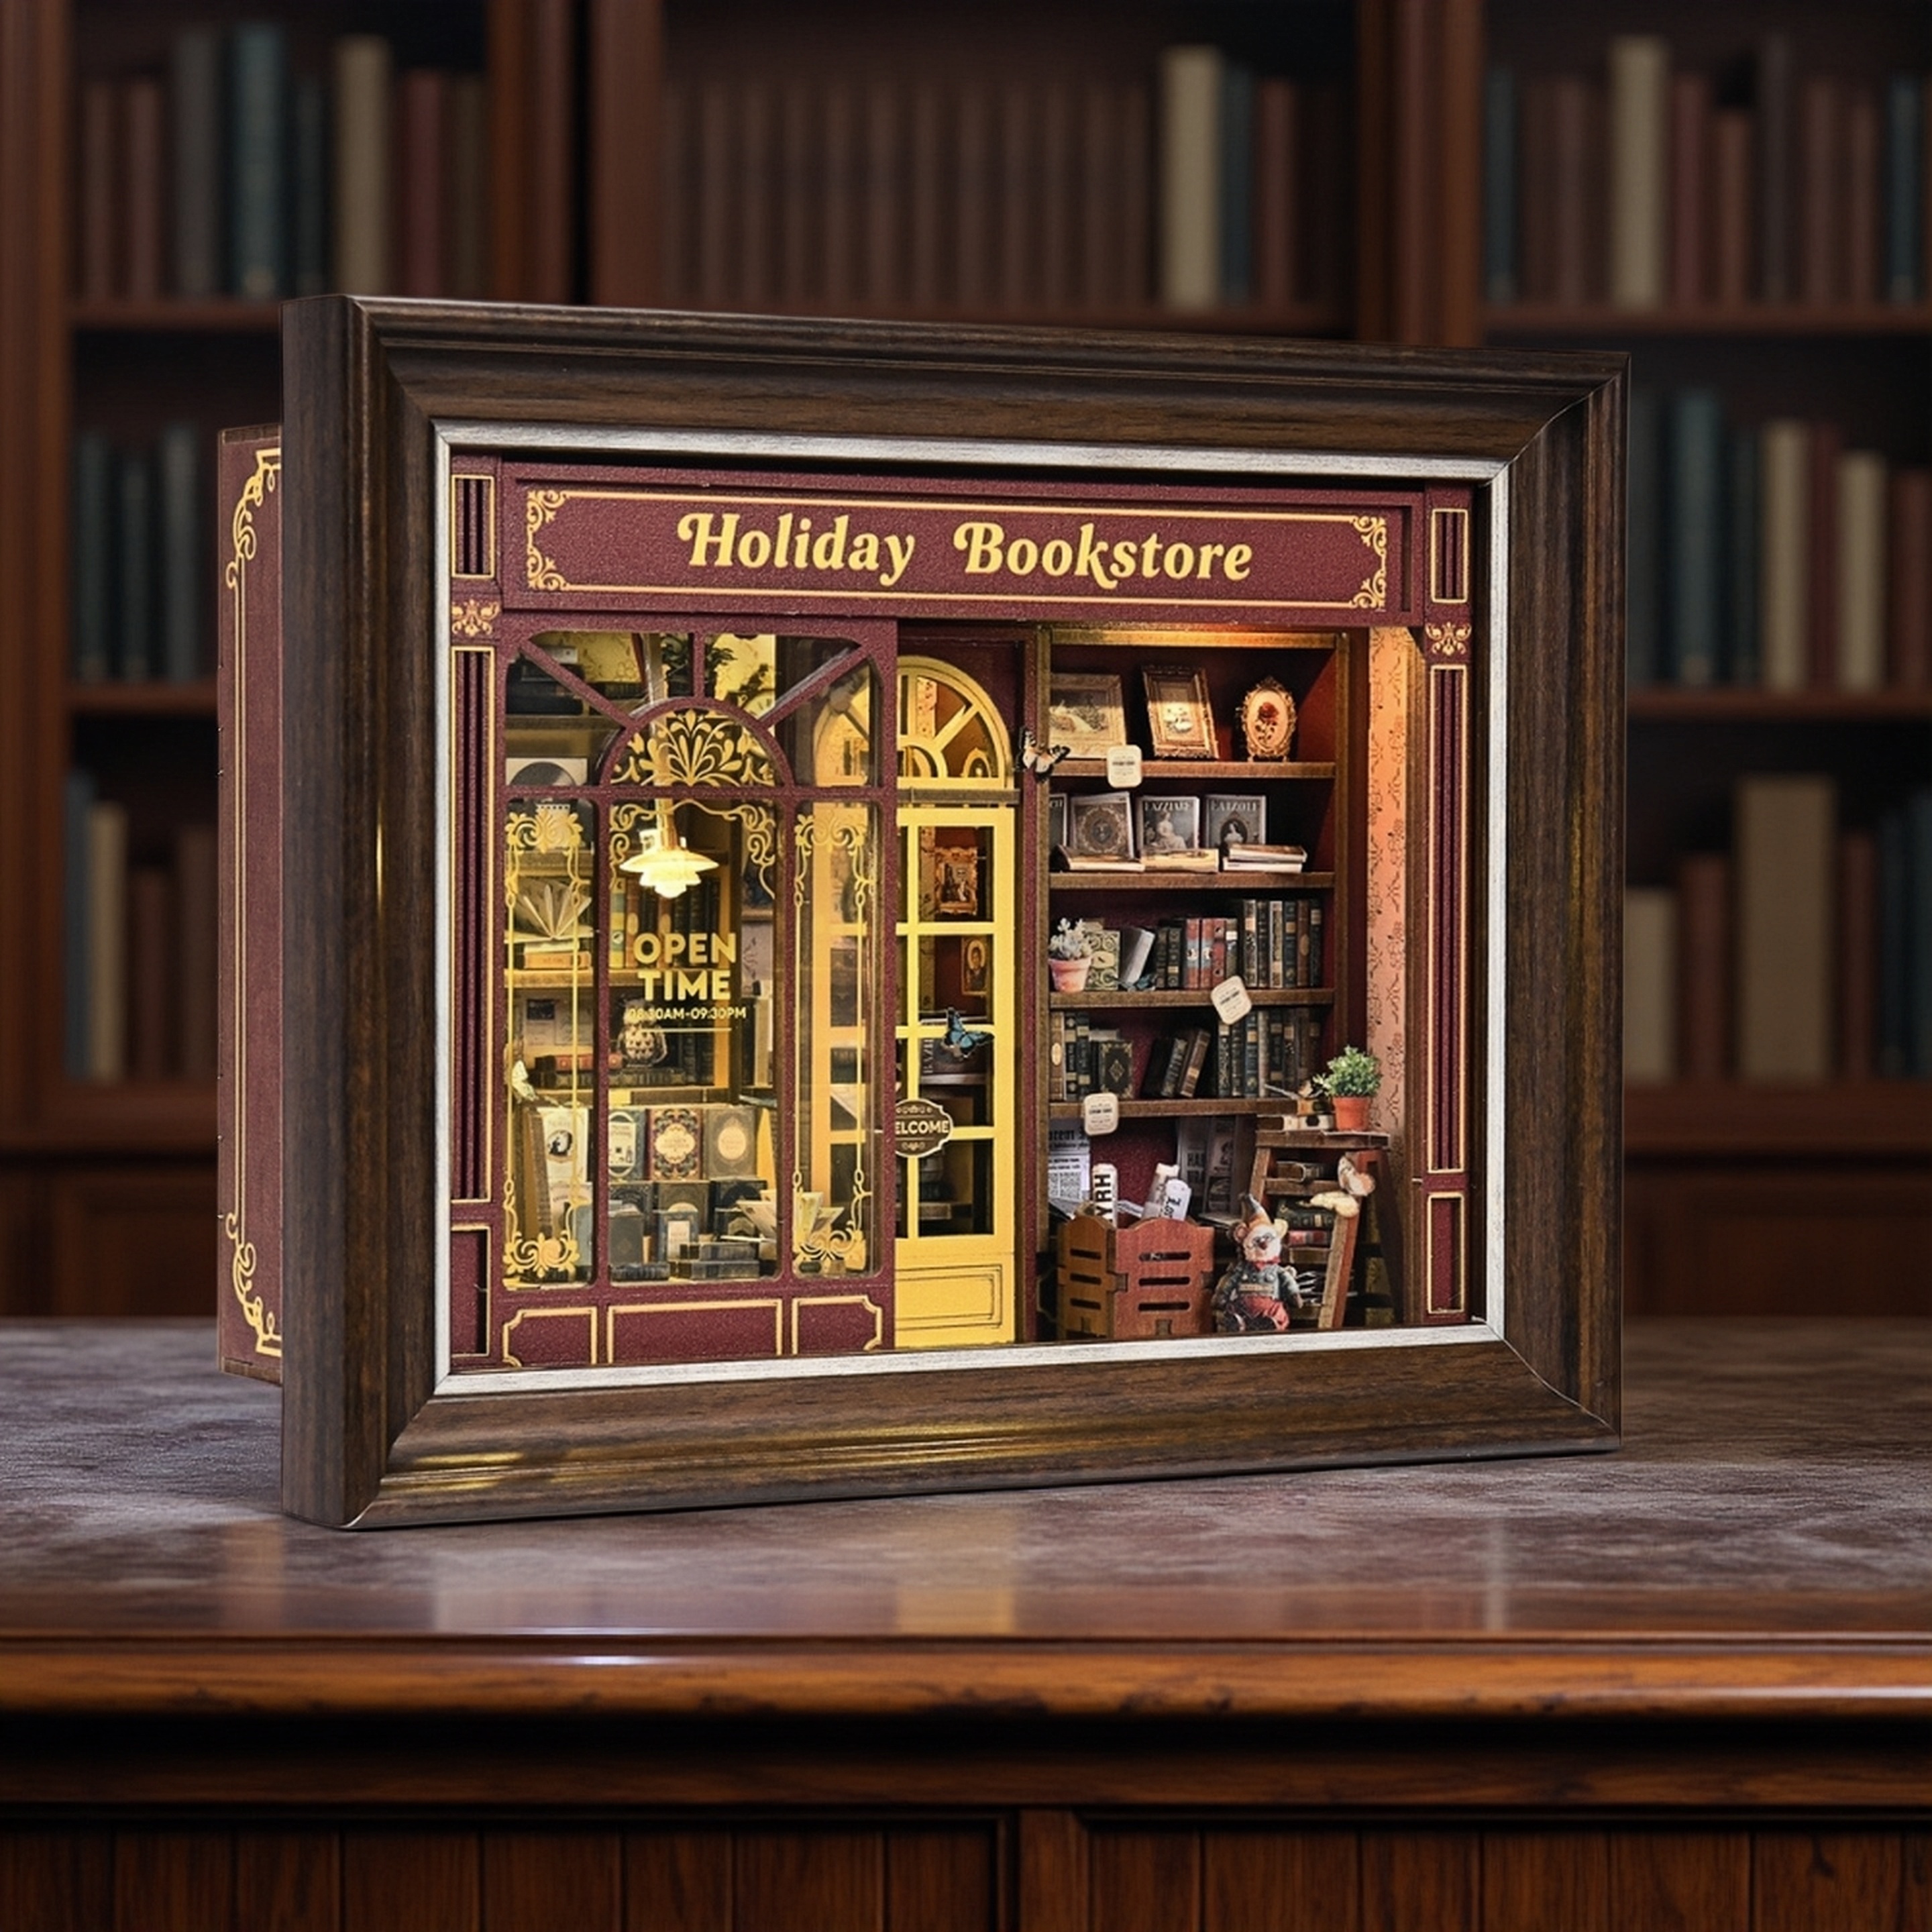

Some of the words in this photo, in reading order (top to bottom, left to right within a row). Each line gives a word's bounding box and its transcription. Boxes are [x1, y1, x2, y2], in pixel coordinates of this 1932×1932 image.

[677, 513, 915, 586] Holiday
[953, 522, 1252, 590] Bookstore
[633, 932, 737, 964] OPEN
[638, 969, 731, 1001] TIME
[895, 1120, 949, 1134] ELCOME
[1094, 1174, 1113, 1222] YRH
